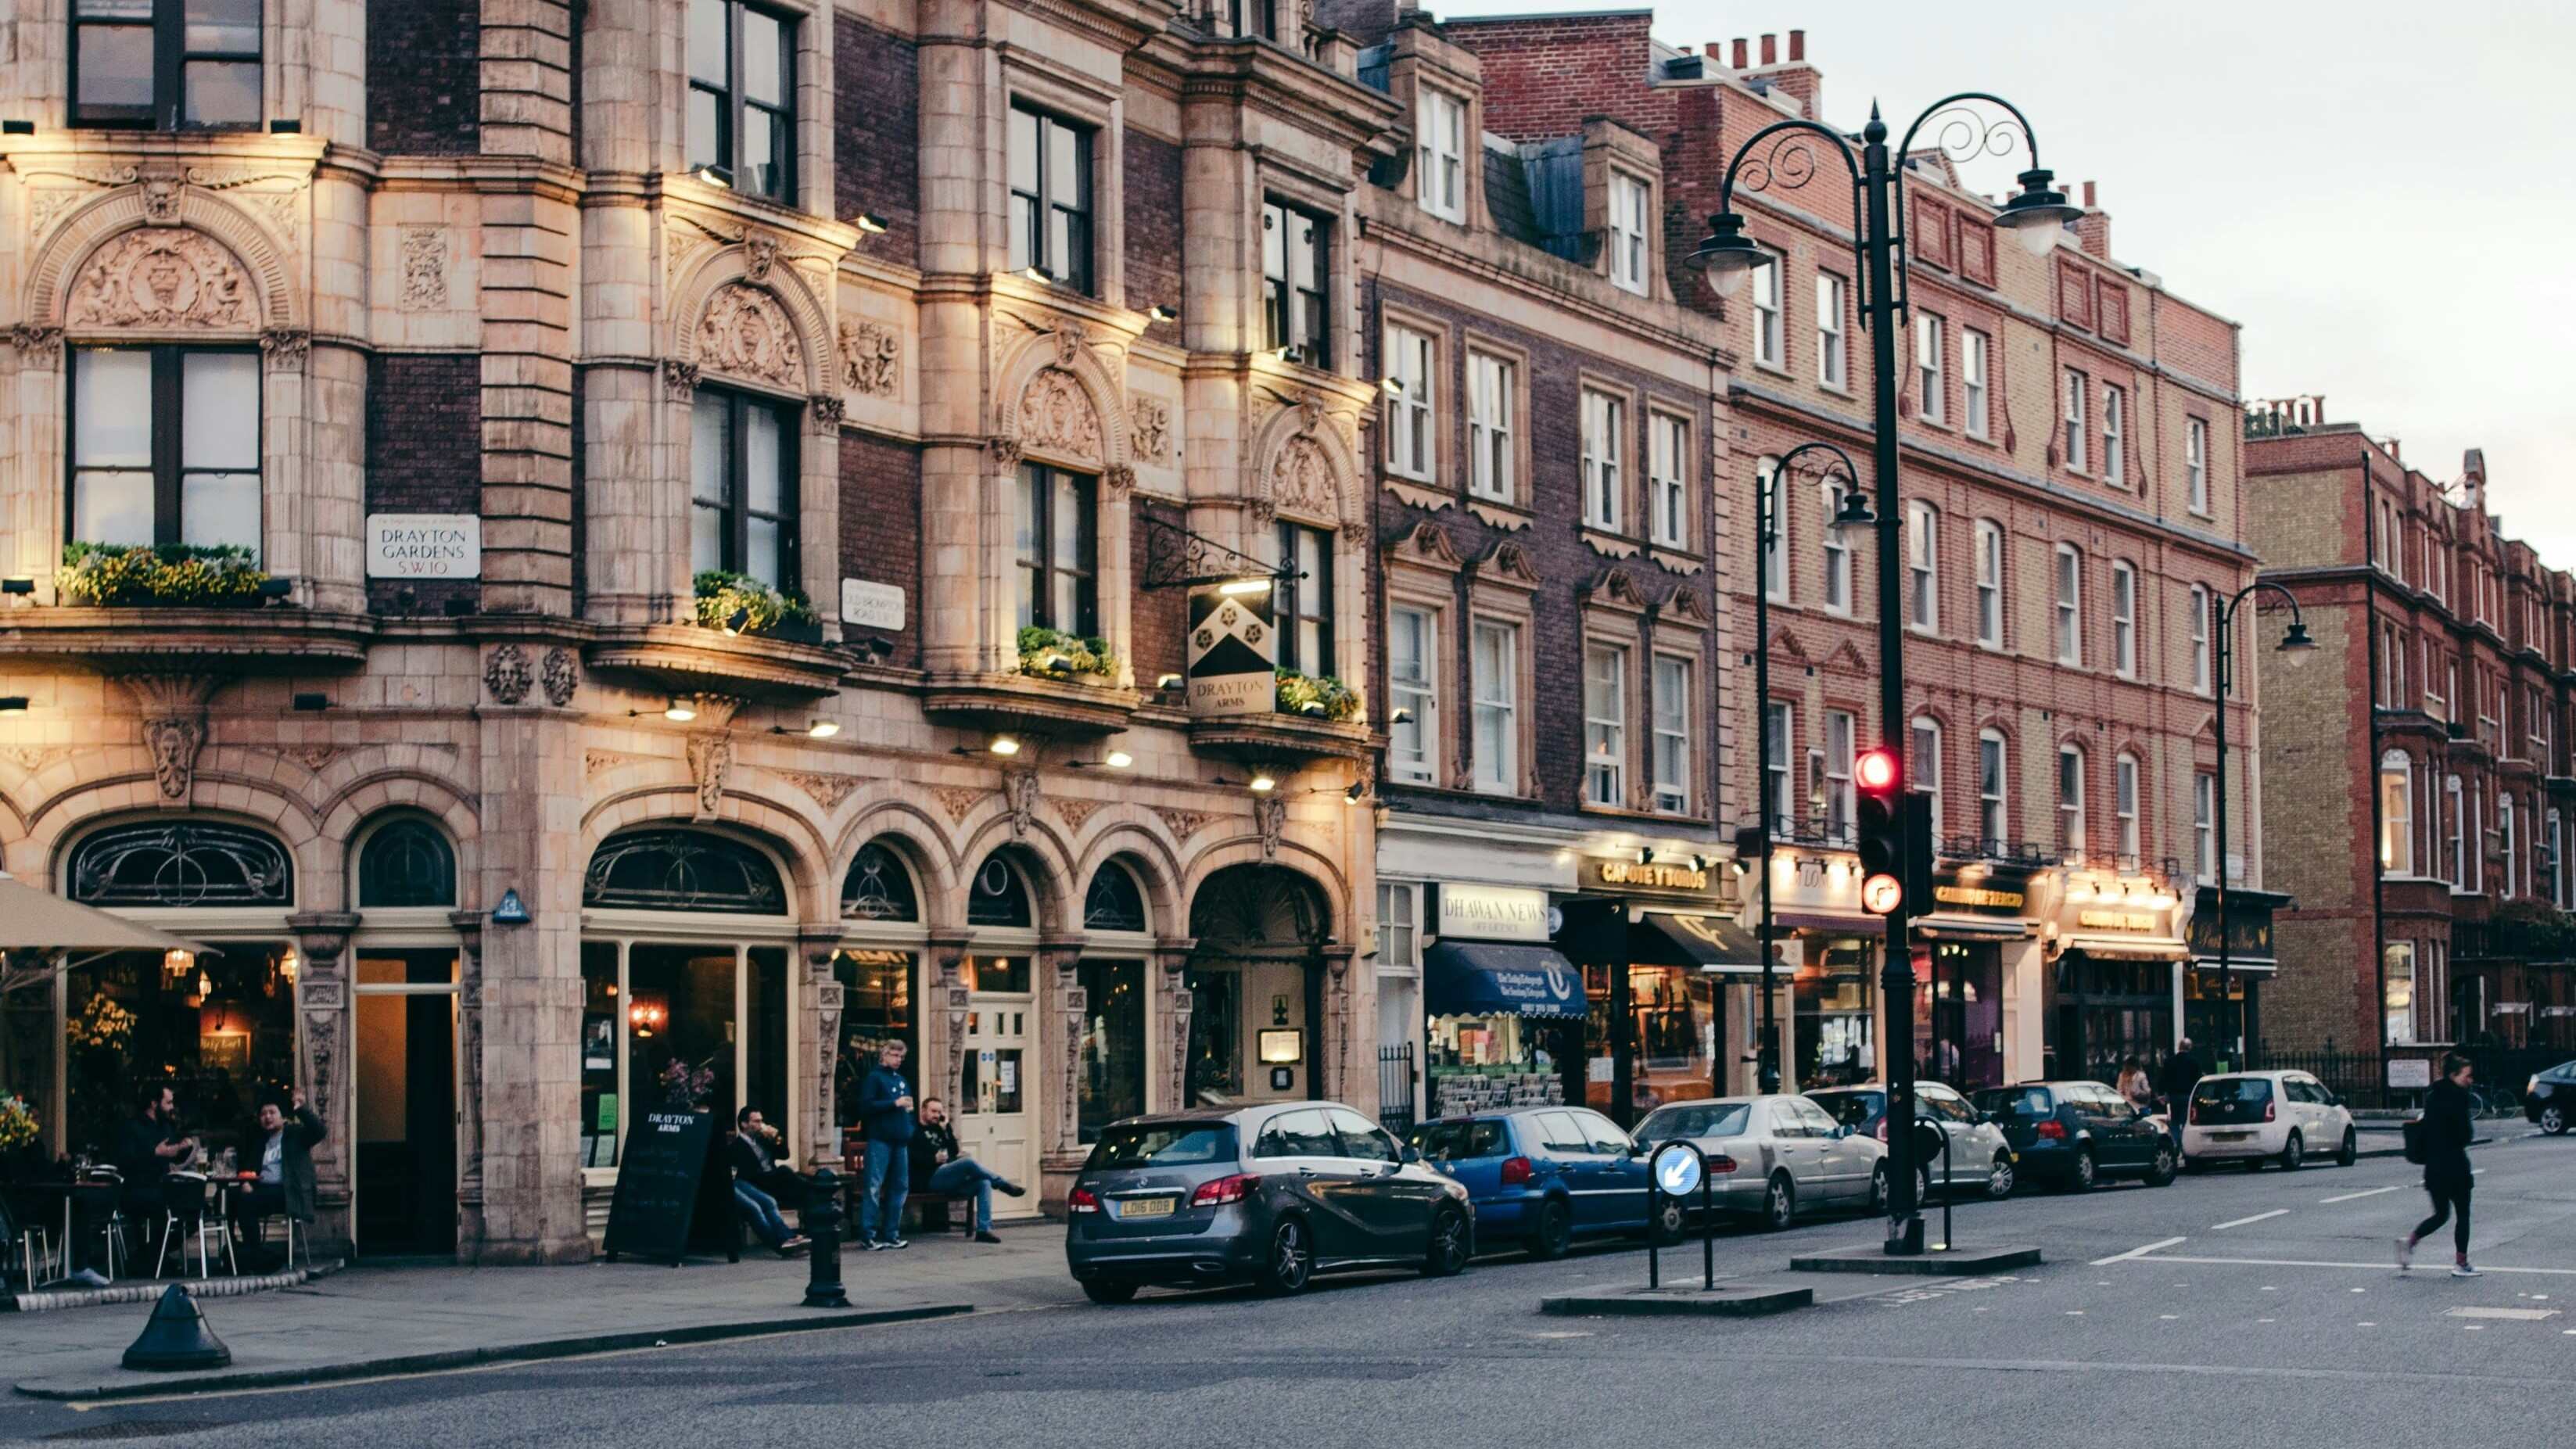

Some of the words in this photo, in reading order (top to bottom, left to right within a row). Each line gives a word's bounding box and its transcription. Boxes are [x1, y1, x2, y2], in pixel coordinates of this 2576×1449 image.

[382, 529, 466, 543] DRAYTON
[382, 545, 465, 559] GARDENS
[1197, 680, 1263, 696] DRAYTON
[1214, 697, 1246, 708] ARMS
[1444, 898, 1503, 920] DHAWAN
[1508, 902, 1546, 922] NEWS
[648, 1113, 695, 1125] DRAYTON
[657, 1124, 681, 1133] ARMS
